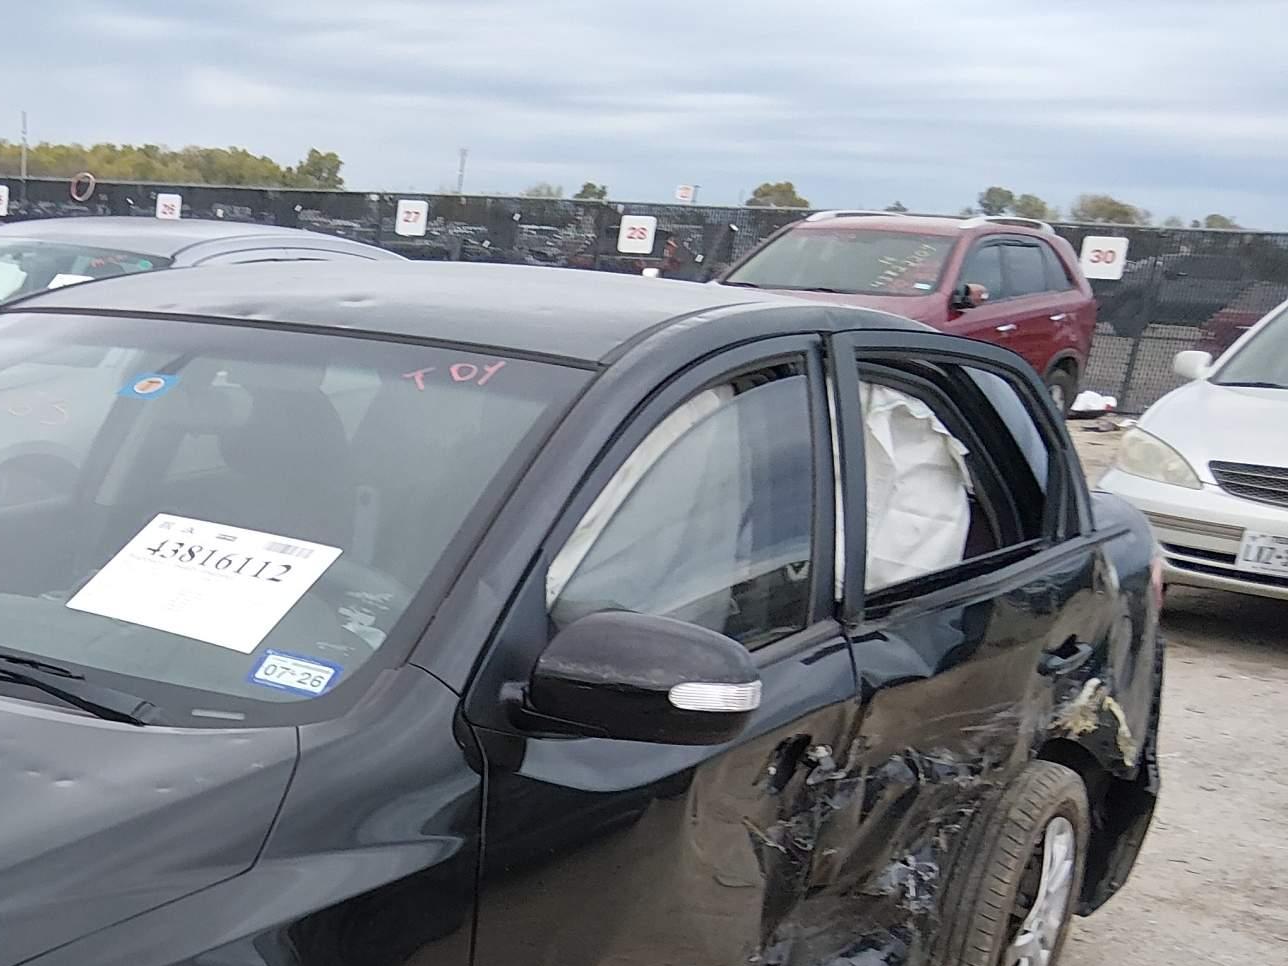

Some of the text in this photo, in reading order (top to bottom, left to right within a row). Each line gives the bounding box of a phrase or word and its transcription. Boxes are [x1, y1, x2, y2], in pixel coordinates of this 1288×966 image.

[402, 209, 420, 224] 27
[626, 225, 648, 240] 28
[1090, 248, 1117, 265] 30
[147, 539, 292, 583] 43816112
